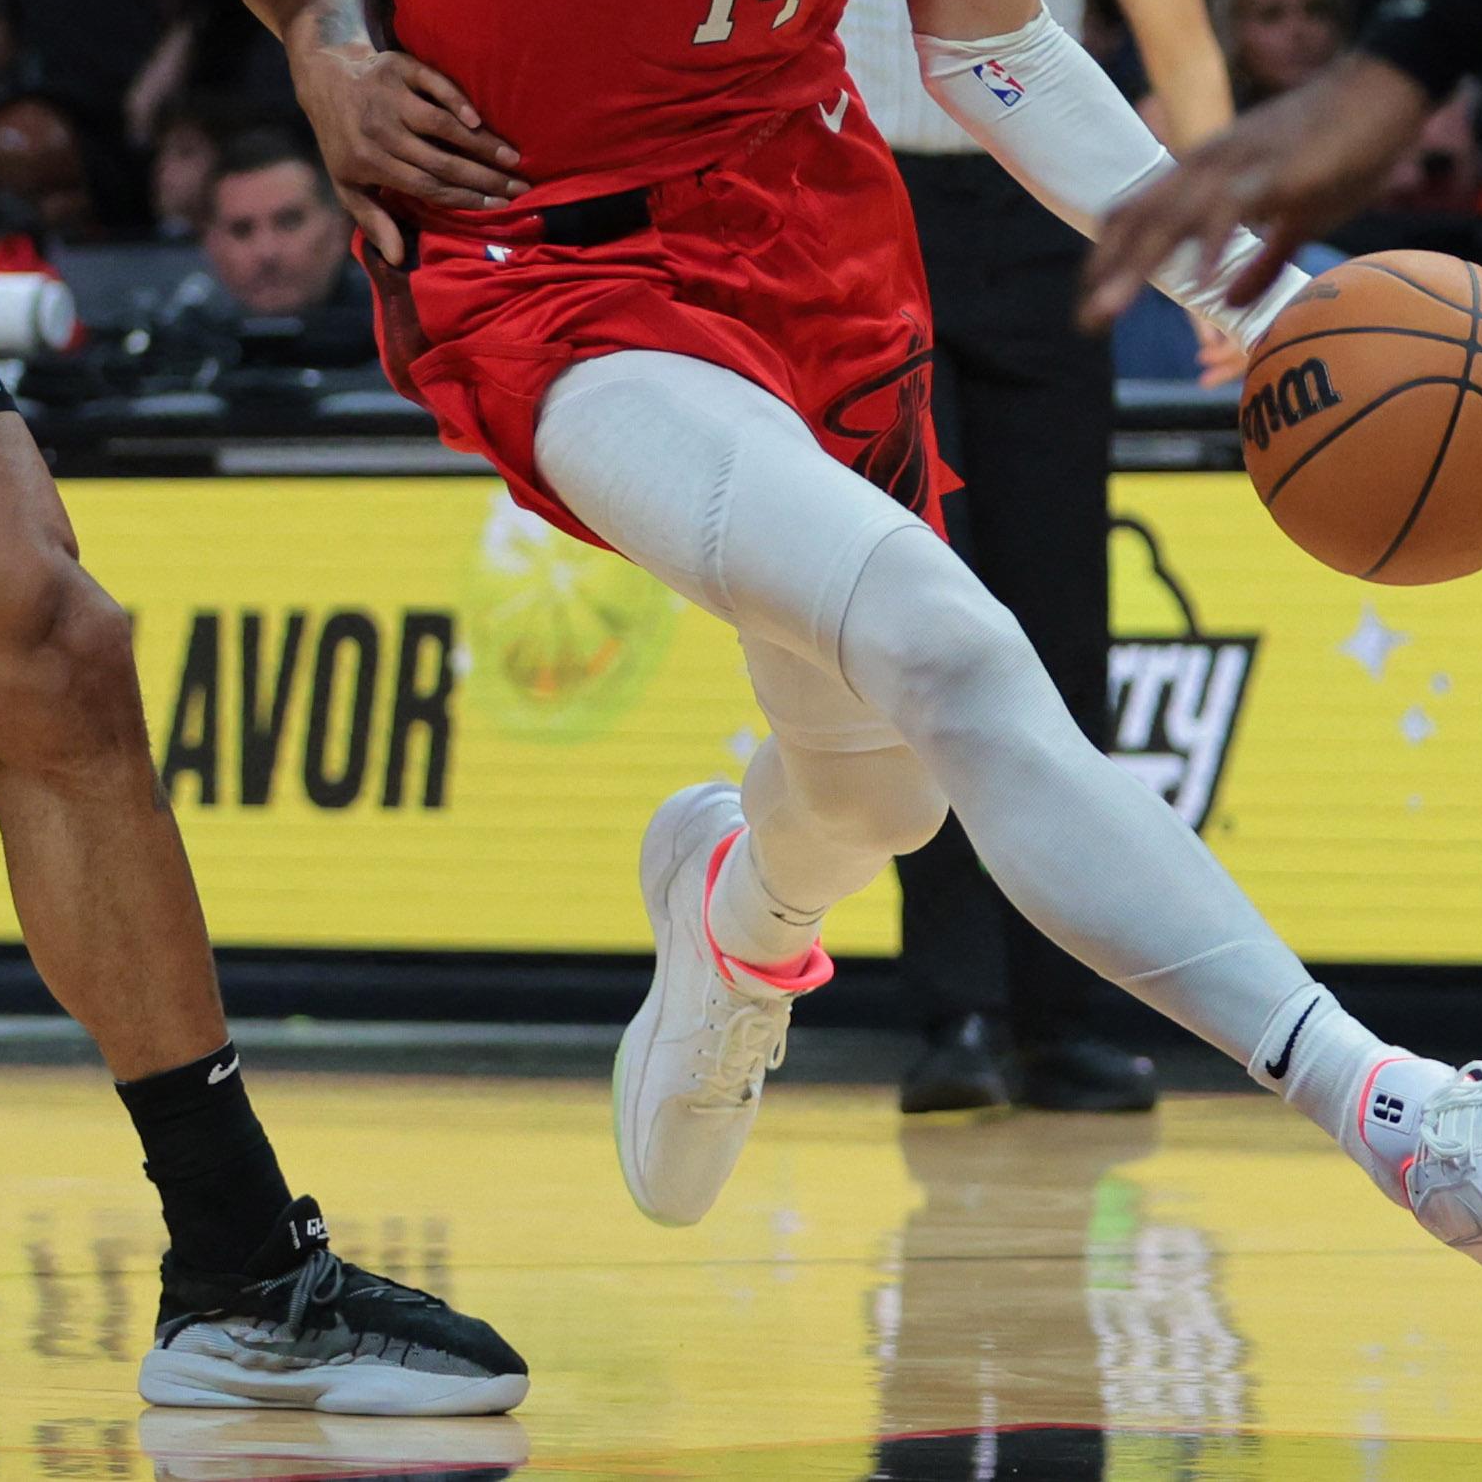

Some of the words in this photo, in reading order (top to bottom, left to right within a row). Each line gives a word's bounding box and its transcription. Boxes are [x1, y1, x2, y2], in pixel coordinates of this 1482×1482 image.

[1242, 357, 1342, 451] Wil
[152, 613, 455, 809] AVOR
[1106, 641, 1253, 834] rry
